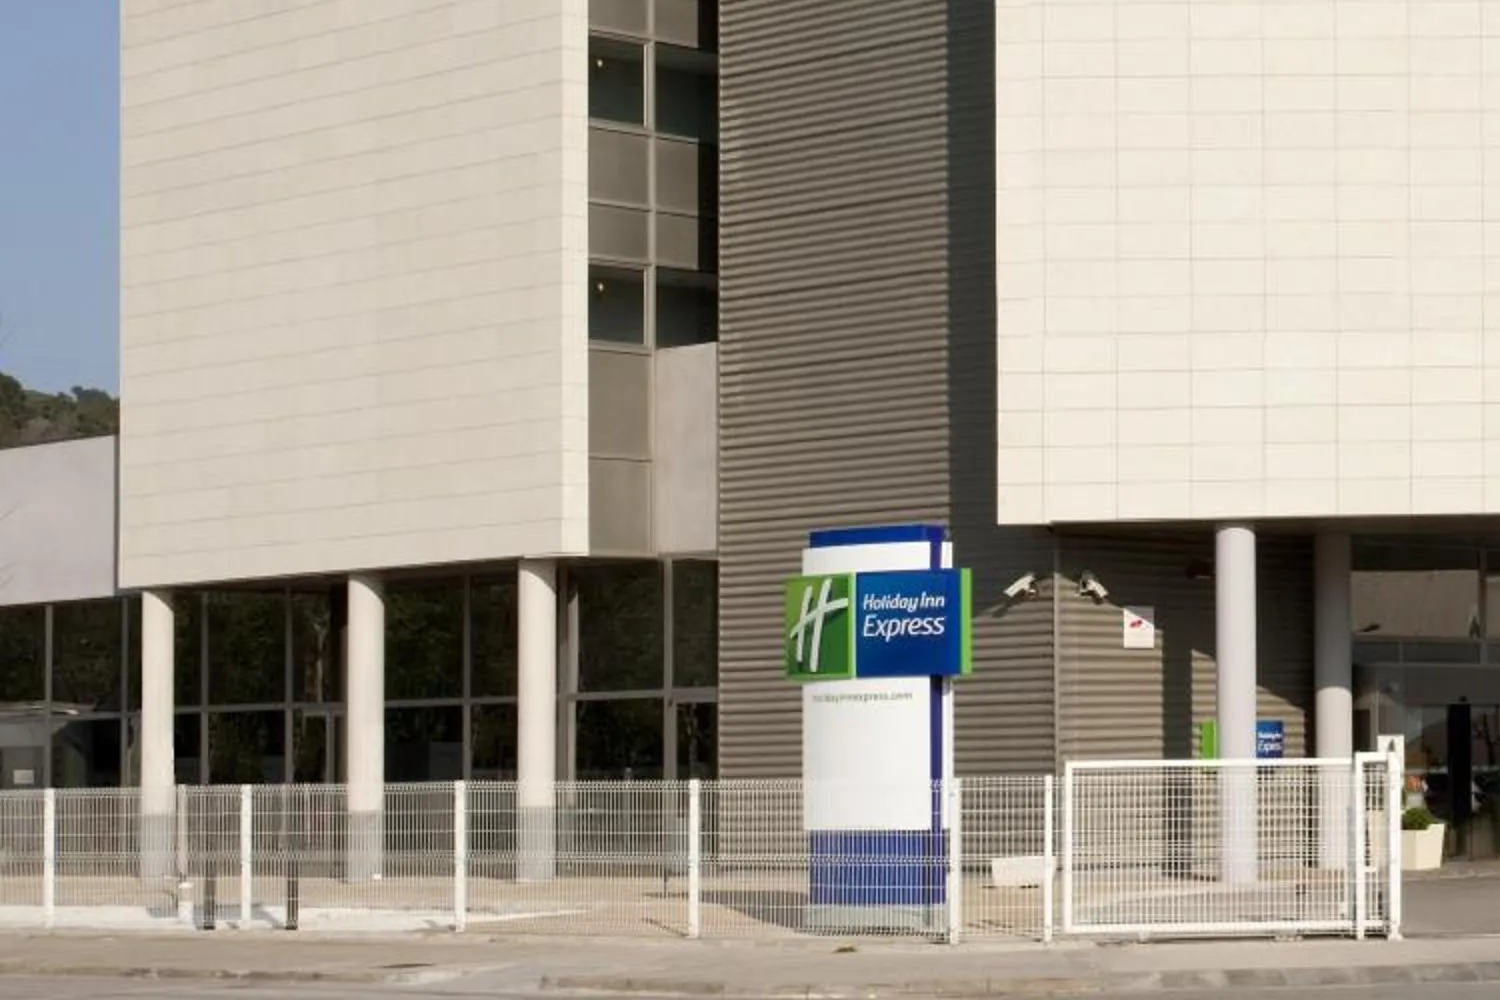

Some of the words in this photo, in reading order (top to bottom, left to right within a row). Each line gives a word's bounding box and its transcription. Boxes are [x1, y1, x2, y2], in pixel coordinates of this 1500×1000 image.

[863, 593, 919, 612] Holiday
[920, 592, 945, 609] Inn
[863, 614, 946, 643] Express
